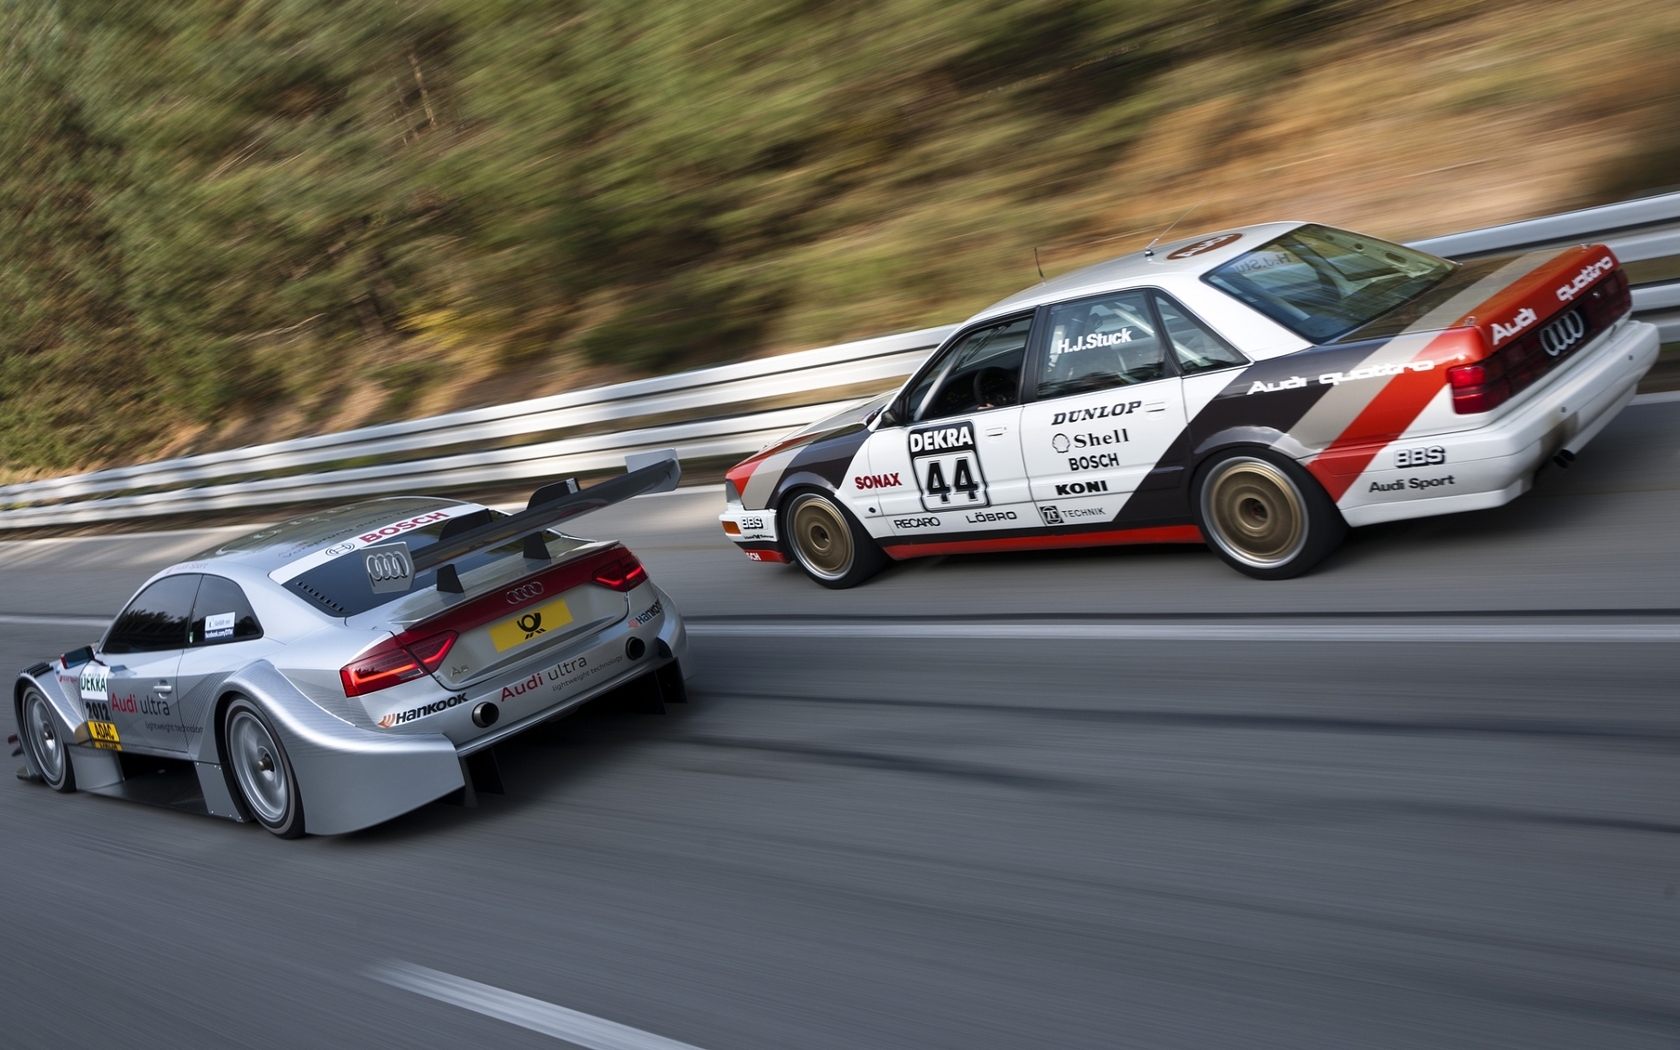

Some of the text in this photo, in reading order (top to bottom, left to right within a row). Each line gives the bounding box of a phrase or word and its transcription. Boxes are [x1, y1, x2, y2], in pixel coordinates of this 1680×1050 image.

[1490, 256, 1614, 346] Audi quattro
[1056, 327, 1133, 354] H.J.Stuck
[1246, 360, 1435, 395] Audi quattro
[1051, 400, 1142, 426] DUNLOP
[909, 426, 973, 453] DEKRA
[1073, 428, 1130, 449] Shell
[1068, 452, 1120, 471] BOSCH
[1394, 445, 1446, 469] BBS
[854, 472, 903, 490] SONAX
[925, 456, 979, 504] 44
[1055, 480, 1109, 496] KONI
[1368, 474, 1456, 493] Audi Sport
[741, 515, 764, 530] BBS
[893, 517, 941, 529] RECARO
[965, 510, 1018, 524] LÖBRO
[1061, 507, 1106, 518] TECHNIK
[358, 511, 450, 544] BOSCH
[80, 673, 107, 692] DEKRA
[500, 656, 588, 702] Audi ultra
[552, 654, 624, 692] lightweight technology
[85, 701, 111, 721] 2012
[111, 692, 171, 716] Audi ultra
[93, 722, 115, 740] ADAC
